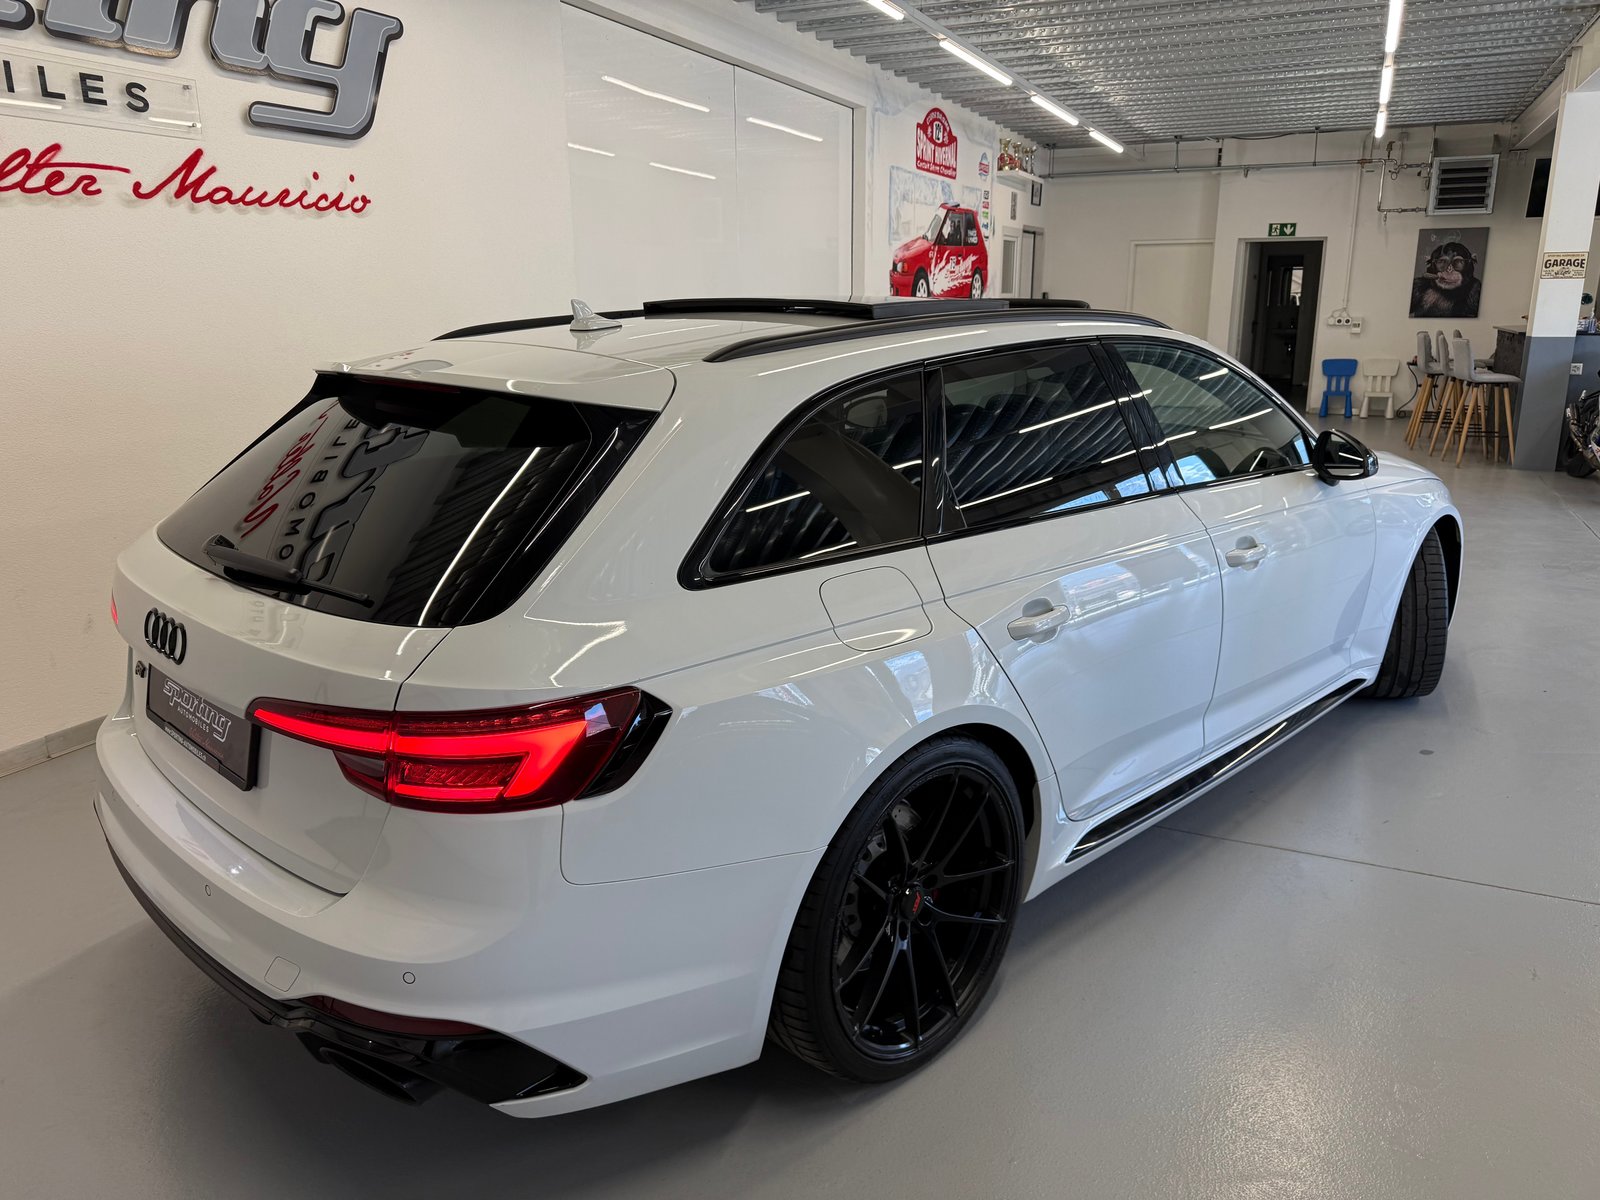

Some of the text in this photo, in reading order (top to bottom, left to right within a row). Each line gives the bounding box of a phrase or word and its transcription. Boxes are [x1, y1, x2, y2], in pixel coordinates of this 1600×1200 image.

[3, 60, 150, 113] ILES
[132, 148, 371, 213] Mauricio
[1544, 258, 1586, 269] GARAGE
[177, 706, 209, 733] AUTOMOBILES
